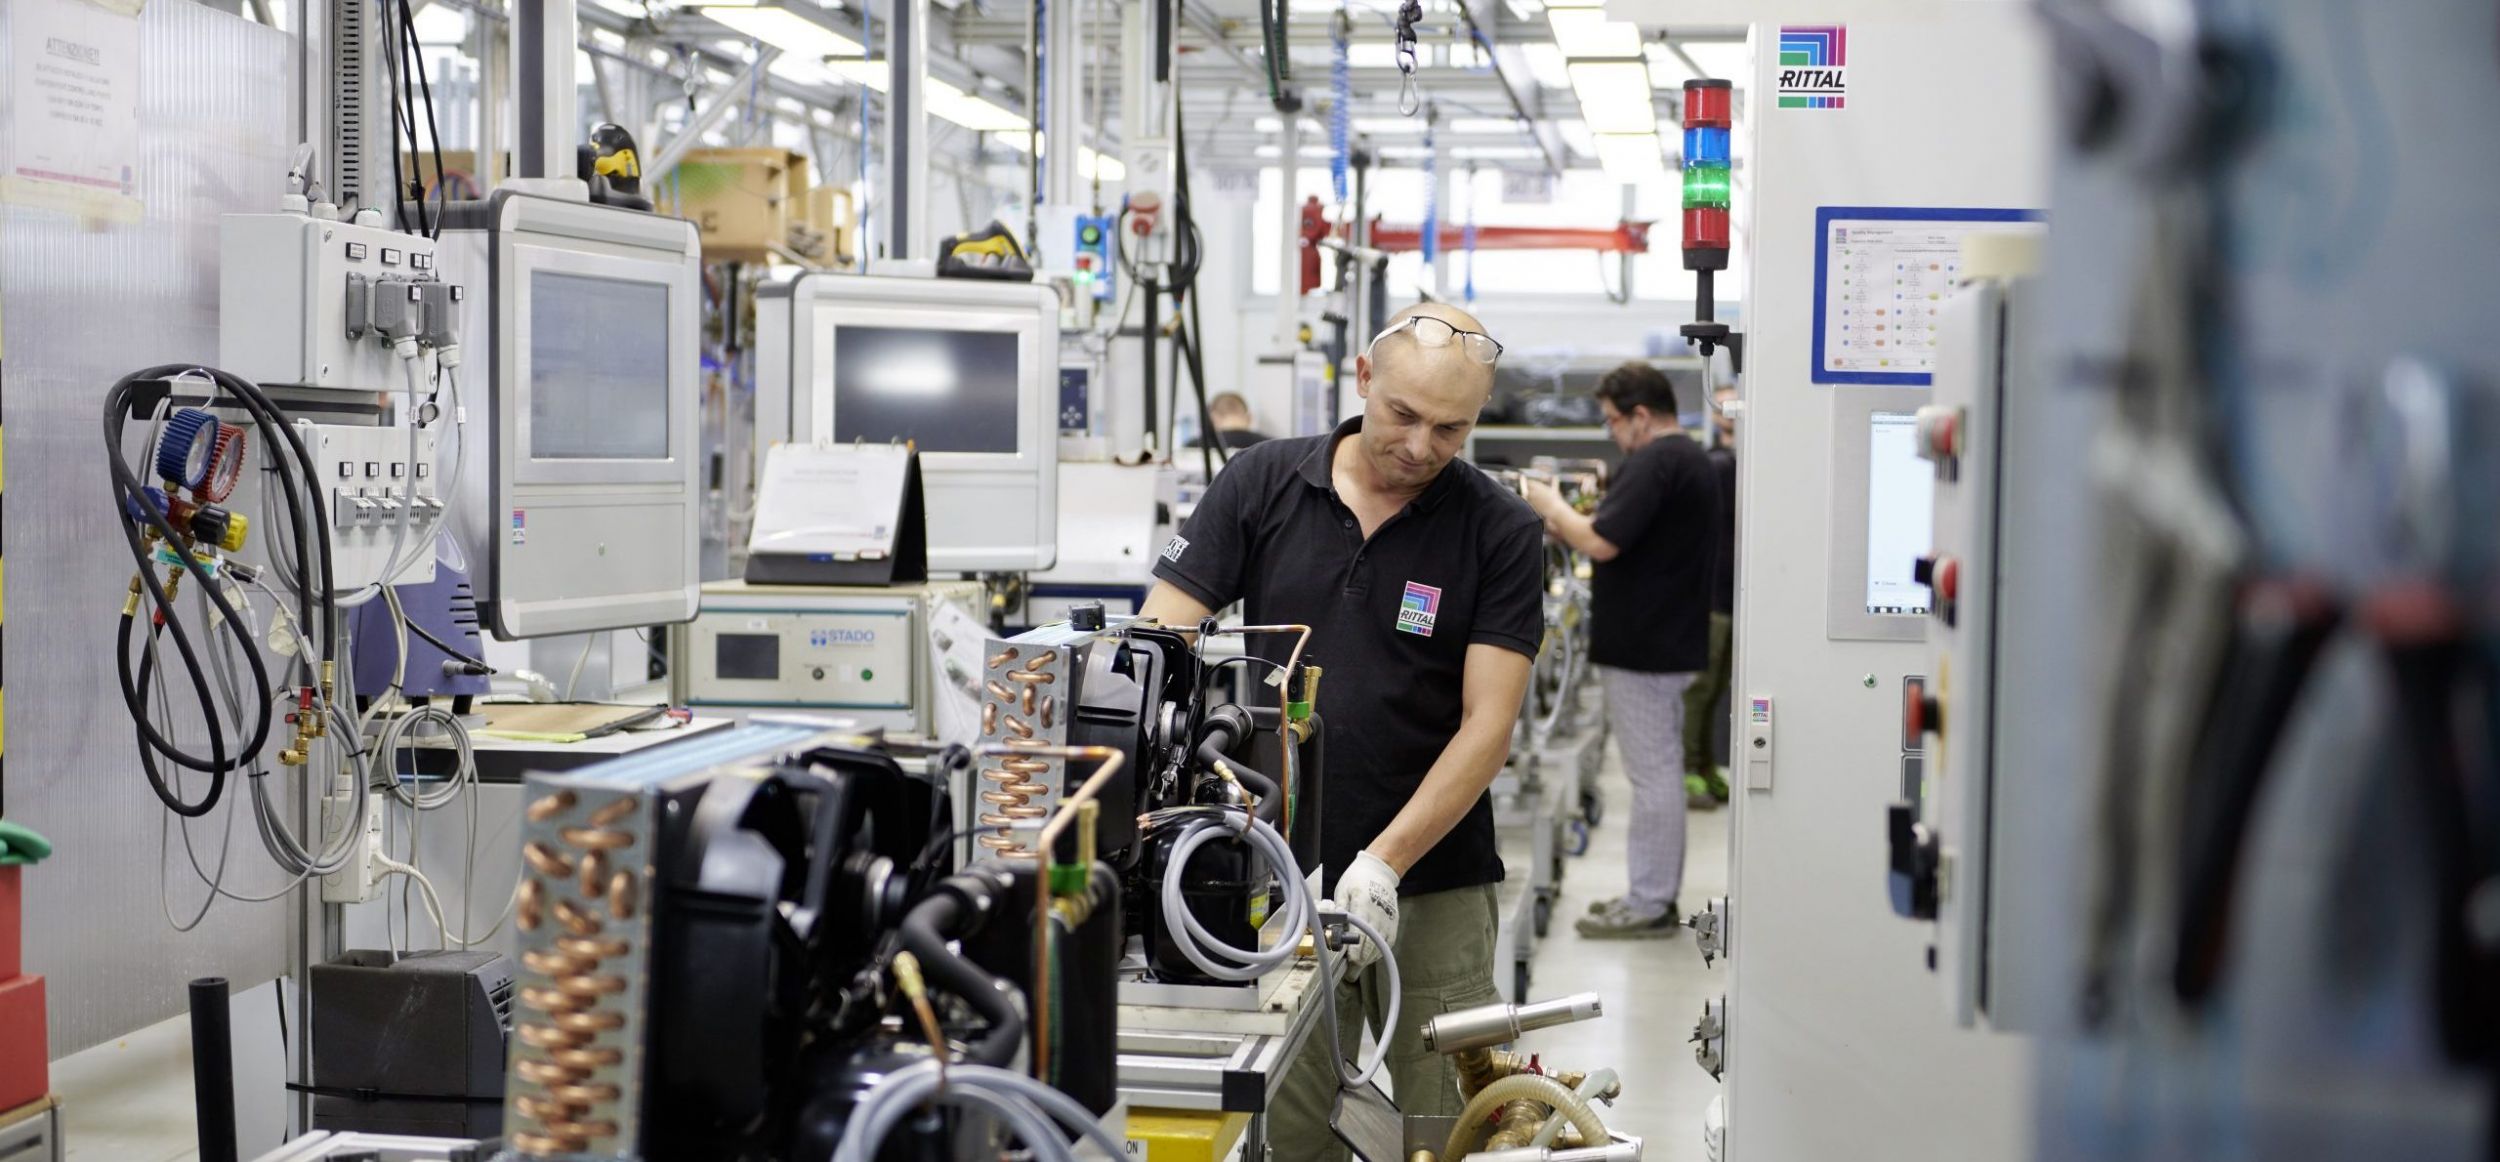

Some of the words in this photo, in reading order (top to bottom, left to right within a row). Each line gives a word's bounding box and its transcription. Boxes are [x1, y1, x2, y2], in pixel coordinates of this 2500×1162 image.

[1779, 70, 1845, 88] RITTAL
[1400, 610, 1434, 626] RITTAL
[828, 629, 875, 642] STADO
